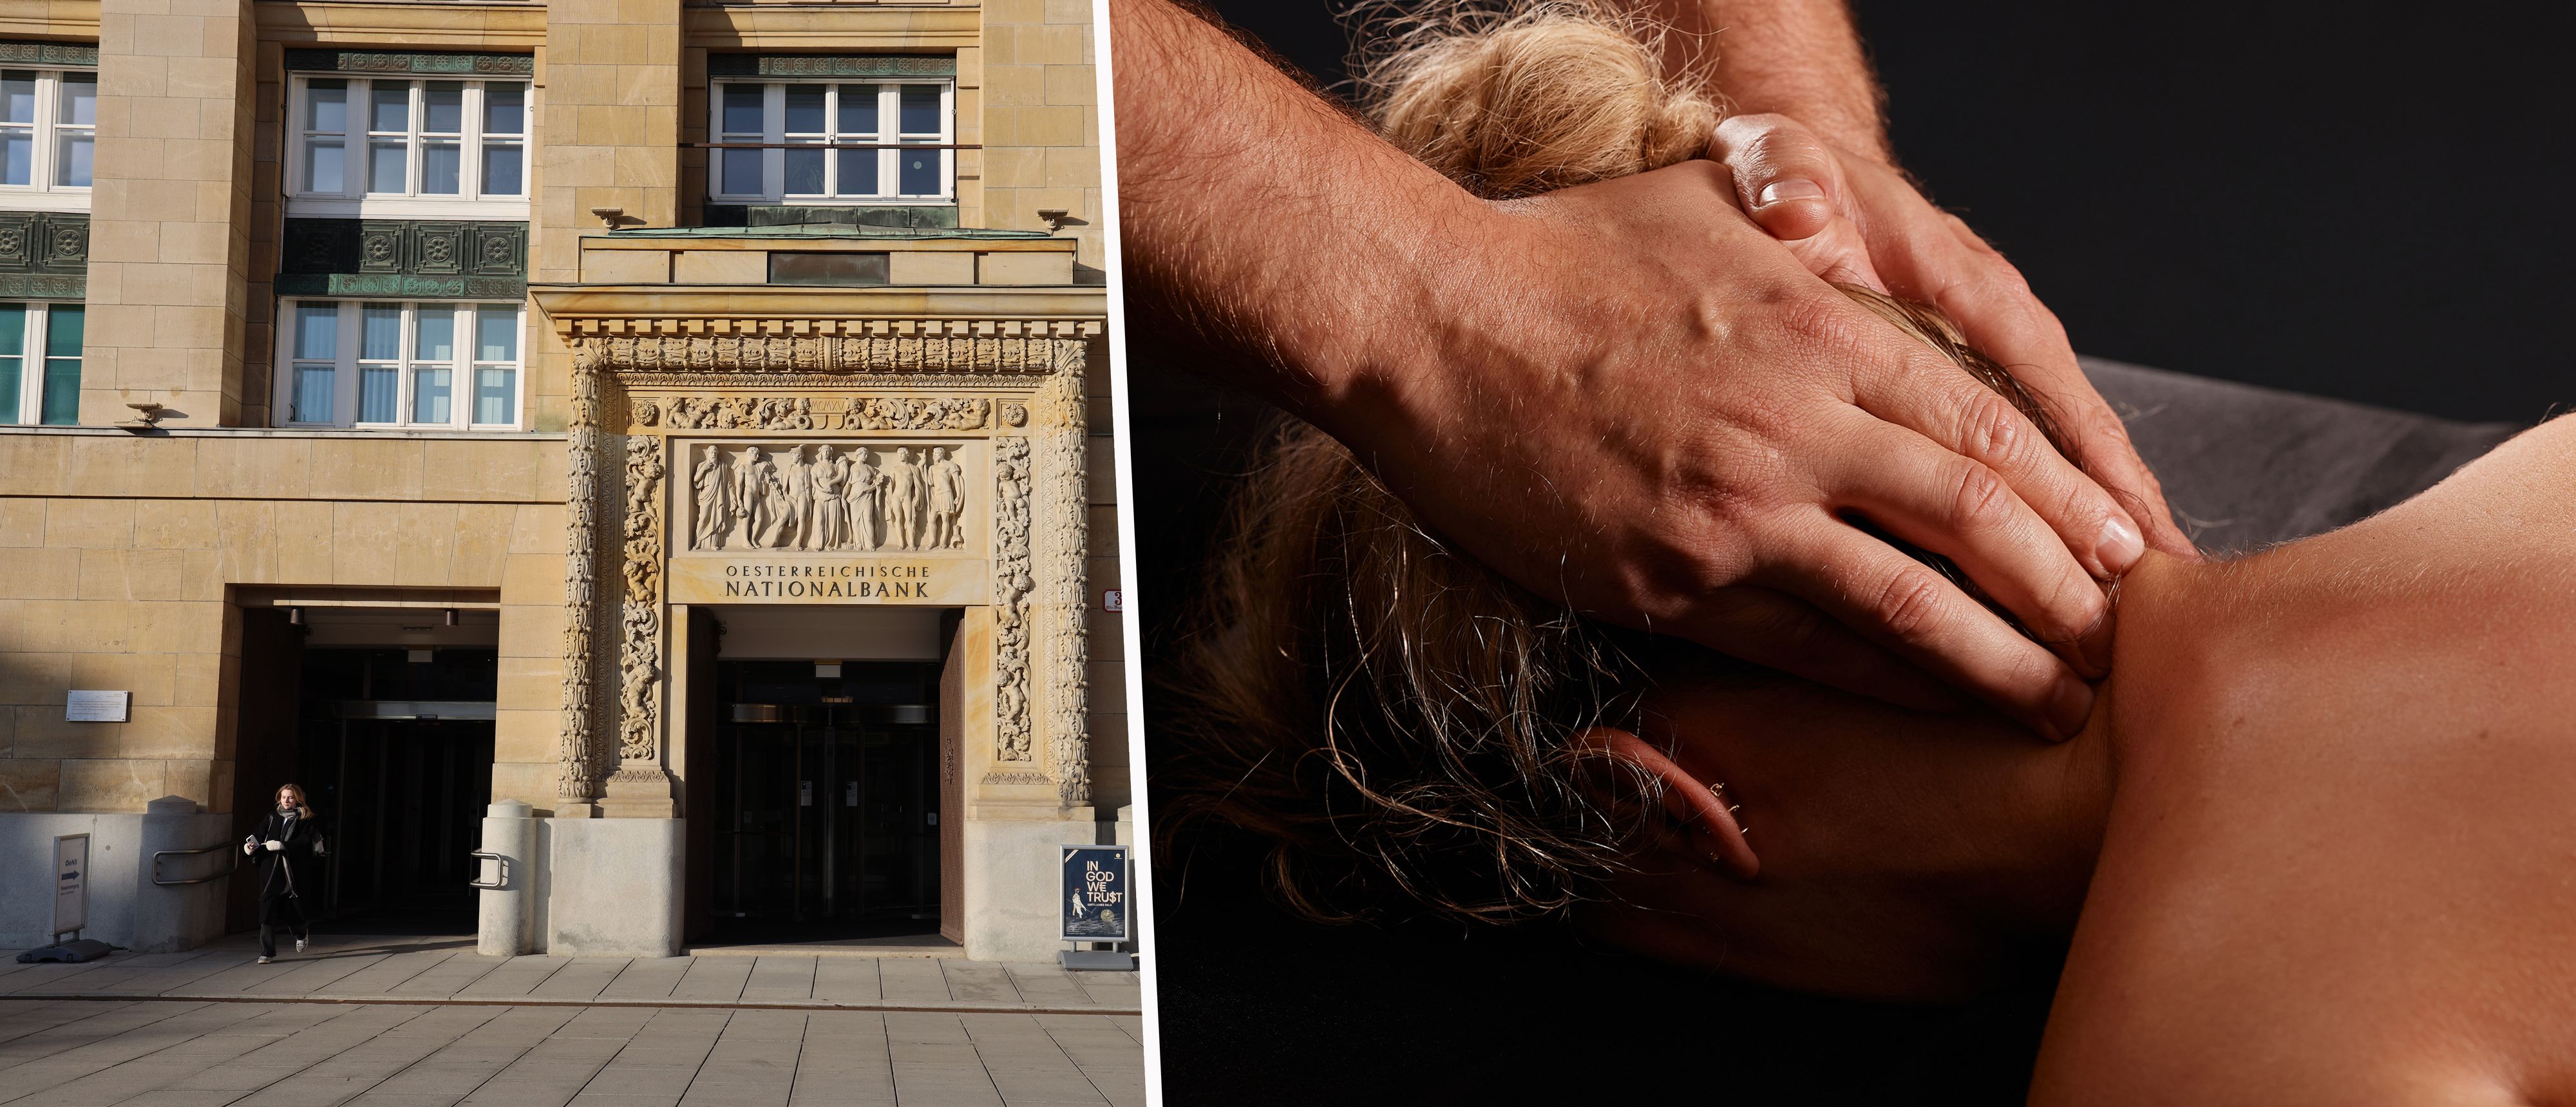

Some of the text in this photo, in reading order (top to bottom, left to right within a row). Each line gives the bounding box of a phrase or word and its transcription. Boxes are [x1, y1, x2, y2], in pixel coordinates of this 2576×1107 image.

[811, 401, 845, 411] MCMXV
[726, 565, 929, 578] OESTERREICHISCHE
[726, 581, 929, 598] NATIONALBANK
[1086, 860, 1099, 871] IN
[1086, 871, 1114, 882] GOD
[1086, 891, 1122, 904] TRU$T
